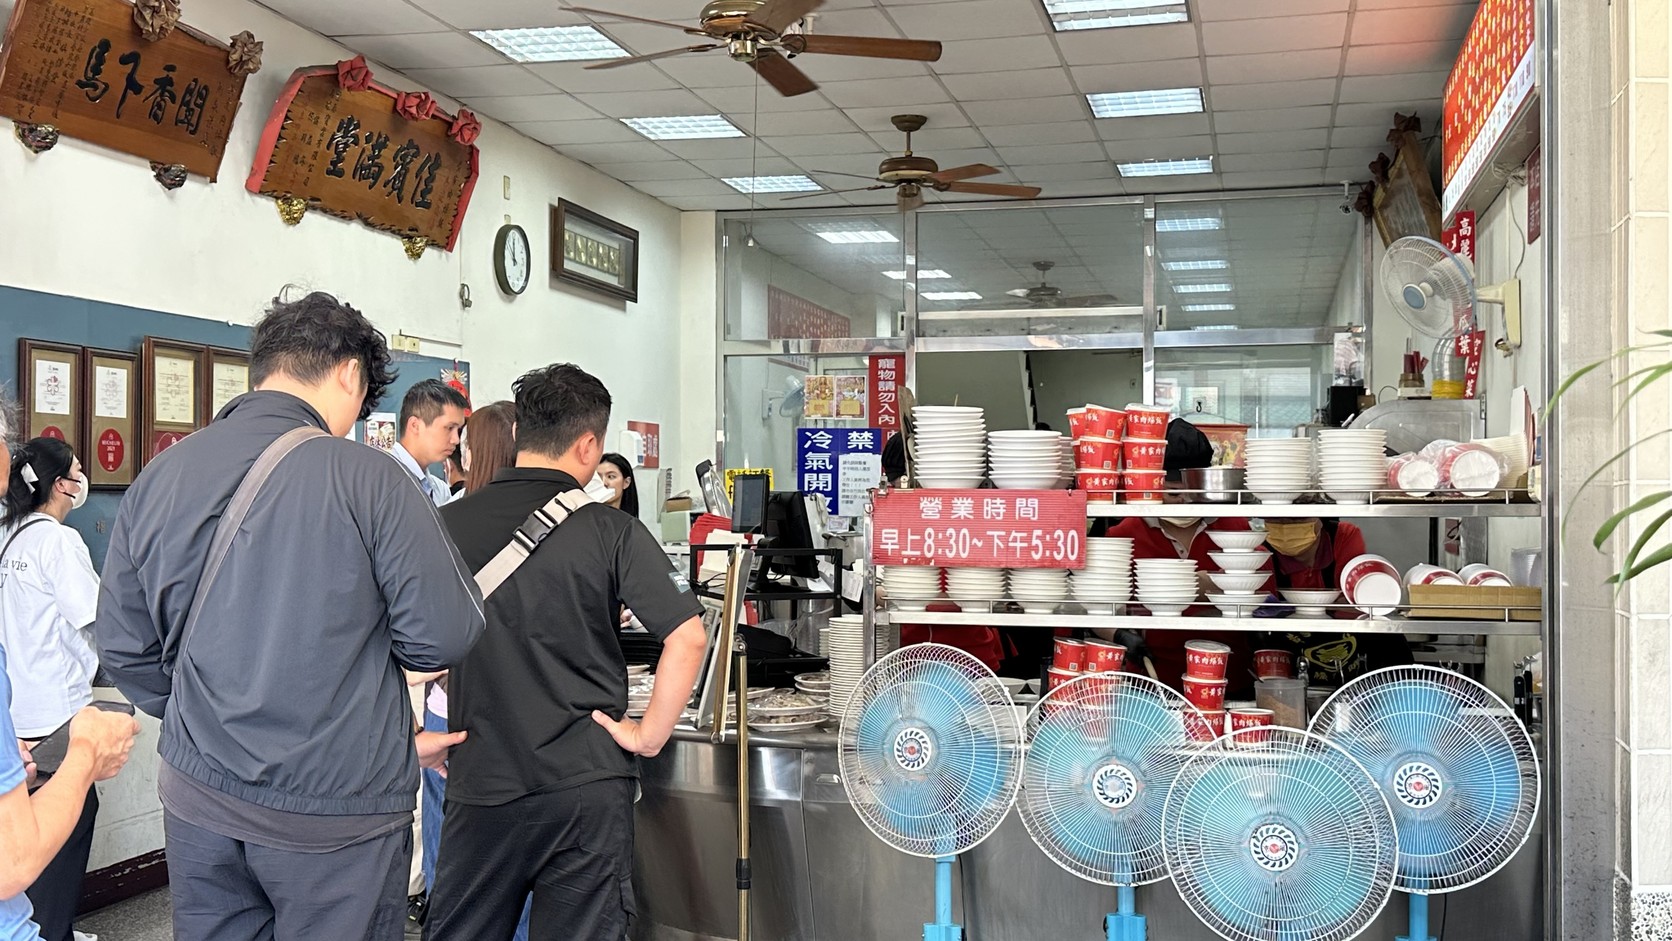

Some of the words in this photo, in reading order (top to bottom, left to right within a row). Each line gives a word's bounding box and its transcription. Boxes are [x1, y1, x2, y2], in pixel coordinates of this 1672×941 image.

[878, 358, 896, 425] 寵物請勿入內
[919, 496, 1039, 521] 營業時間
